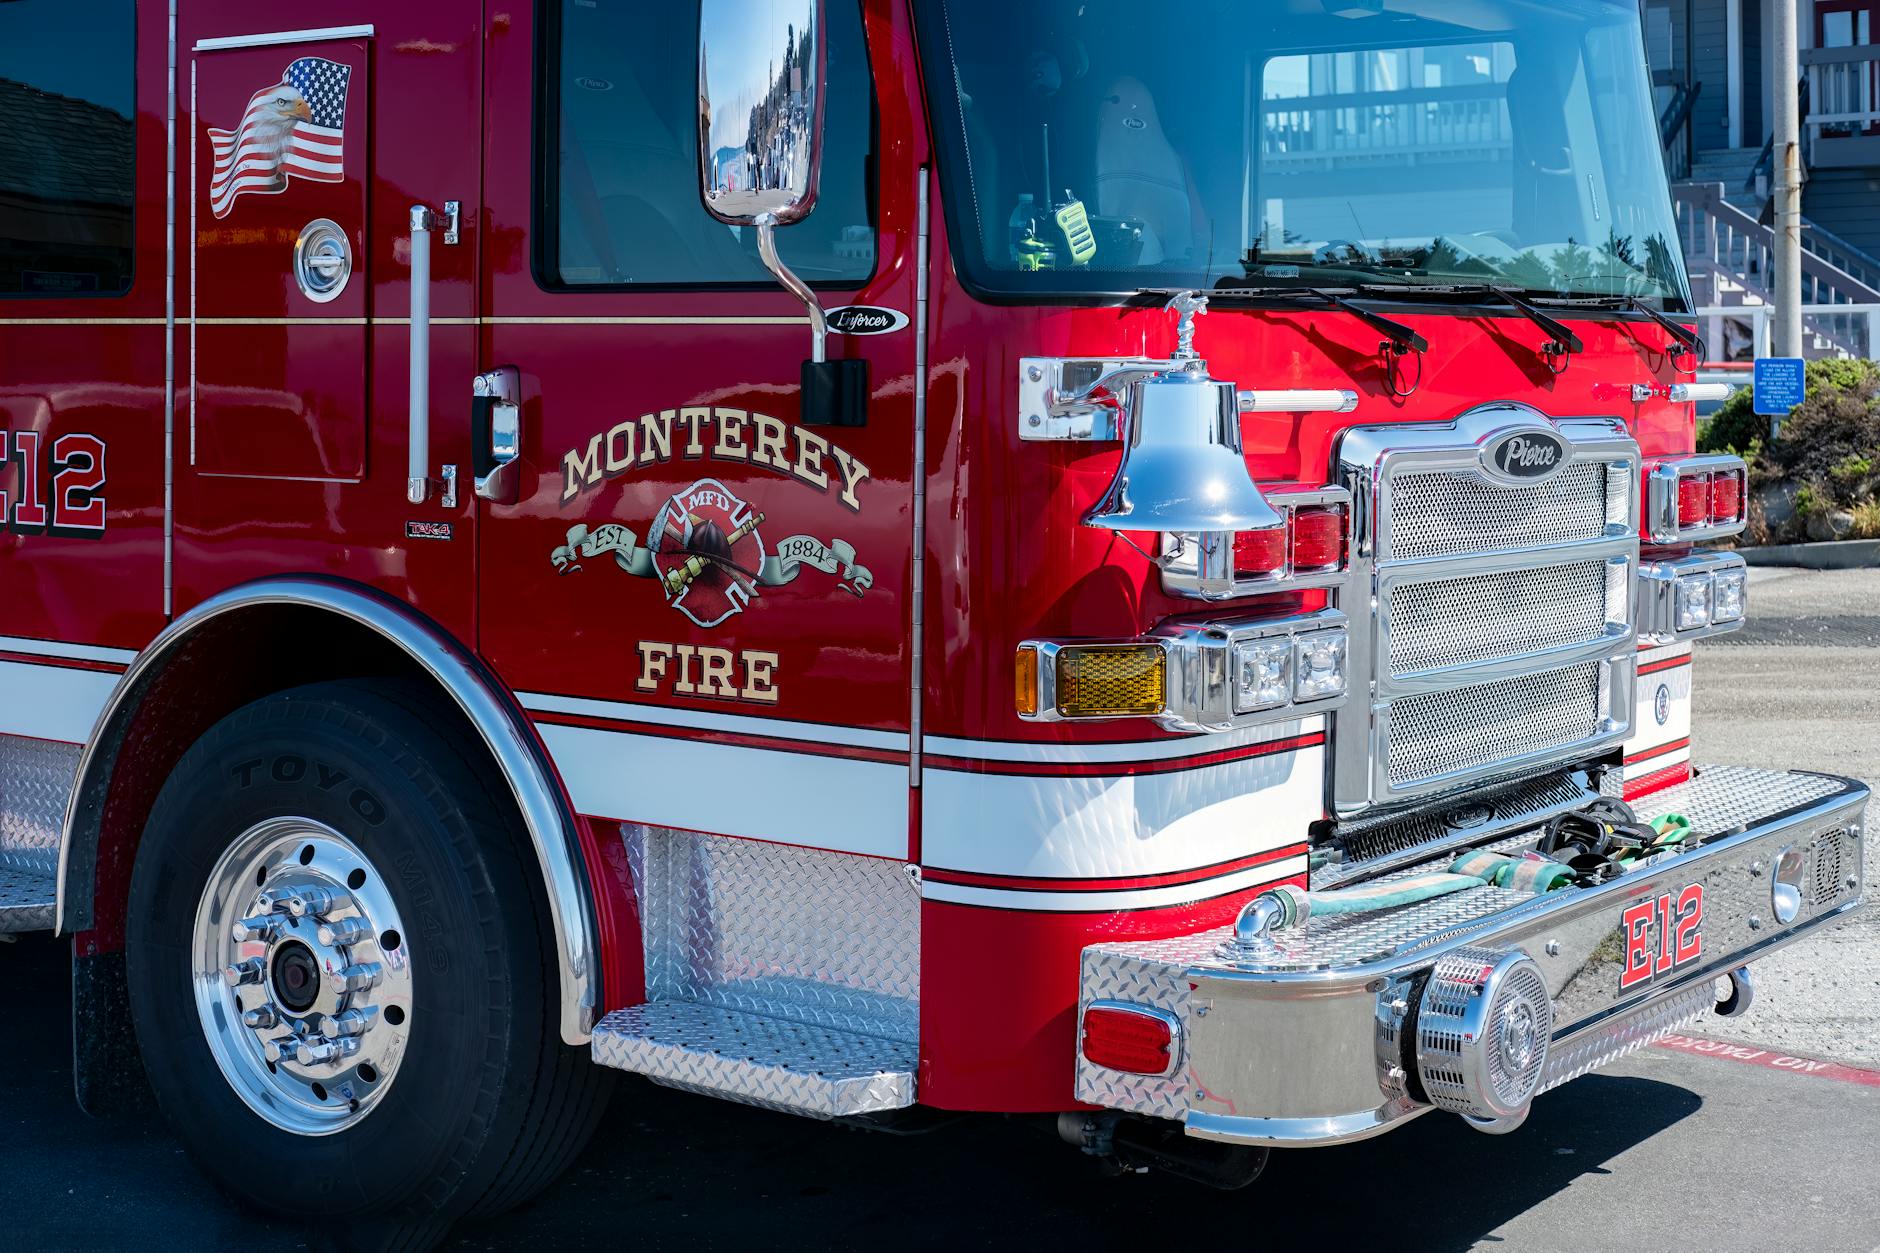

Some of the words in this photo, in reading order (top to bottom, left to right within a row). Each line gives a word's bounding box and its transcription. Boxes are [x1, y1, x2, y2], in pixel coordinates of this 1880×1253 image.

[837, 311, 888, 331] Enforcer
[562, 406, 871, 511] MONTEREY
[1503, 436, 1555, 473] Pierce
[0, 430, 106, 530] 12
[688, 490, 730, 511] MFD
[408, 521, 451, 535] TAK-4
[595, 525, 628, 548] EST.
[782, 539, 826, 564] 1884
[637, 640, 779, 702] FIRE
[231, 754, 388, 828] TOYO
[1620, 882, 1704, 989] E12
[1771, 1056, 1828, 1072] NO
